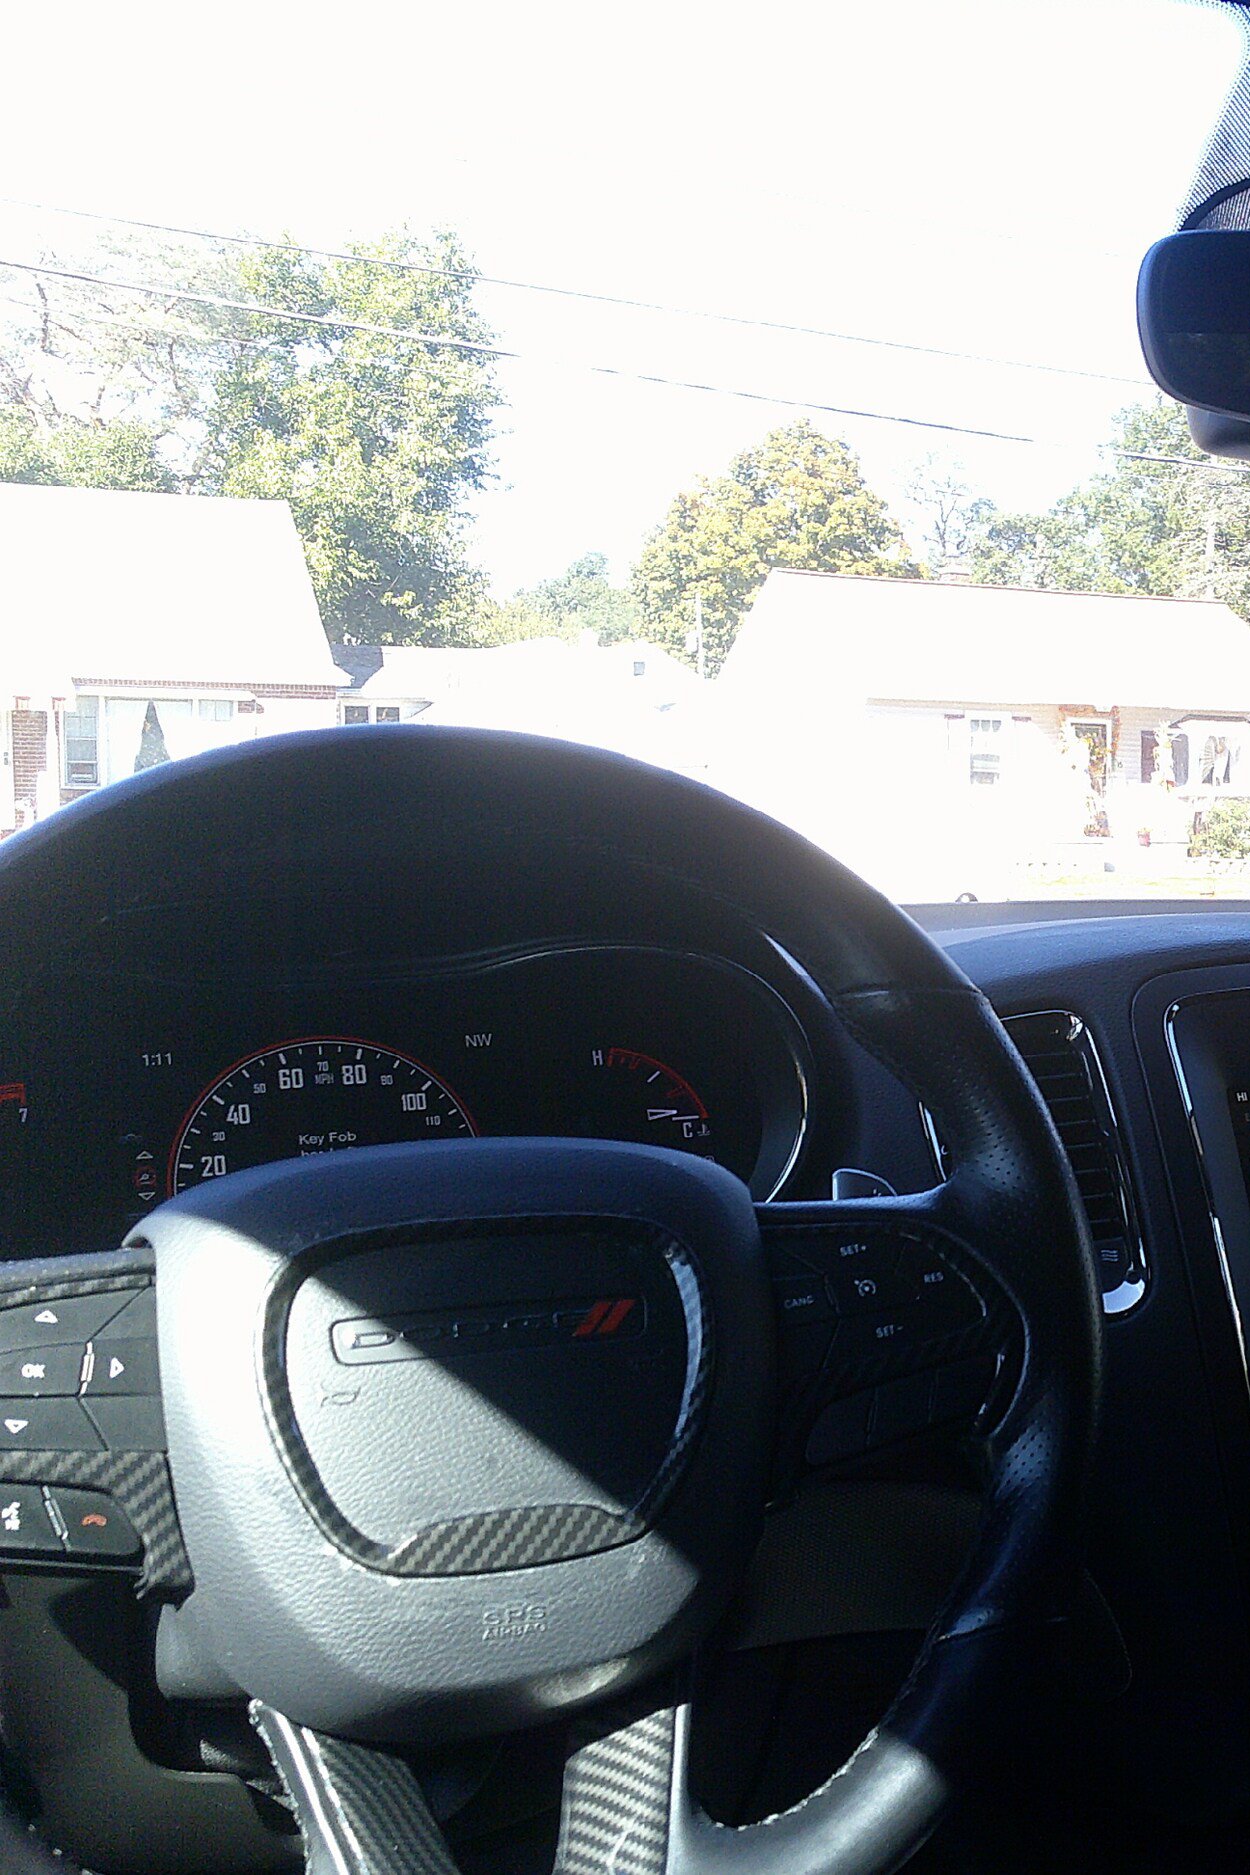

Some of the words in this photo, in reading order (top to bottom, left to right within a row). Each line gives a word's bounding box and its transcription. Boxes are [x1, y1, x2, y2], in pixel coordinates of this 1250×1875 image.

[464, 1033, 493, 1048] NW
[141, 1052, 173, 1067] 1:11
[317, 1060, 330, 1072] 70
[592, 1049, 604, 1067] H
[277, 1067, 305, 1090] 60
[314, 1073, 335, 1085] MPH
[341, 1063, 368, 1086] 80
[252, 1082, 267, 1095] 50
[400, 1092, 428, 1112] 100
[18, 1107, 28, 1123] 7
[225, 1103, 251, 1126] 40
[425, 1115, 442, 1127] 110
[211, 1131, 226, 1142] 30
[681, 1121, 694, 1139] C
[298, 1133, 326, 1147] Key
[328, 1131, 357, 1143] Fob
[200, 1154, 227, 1178] 20
[20, 1362, 46, 1379] OK
